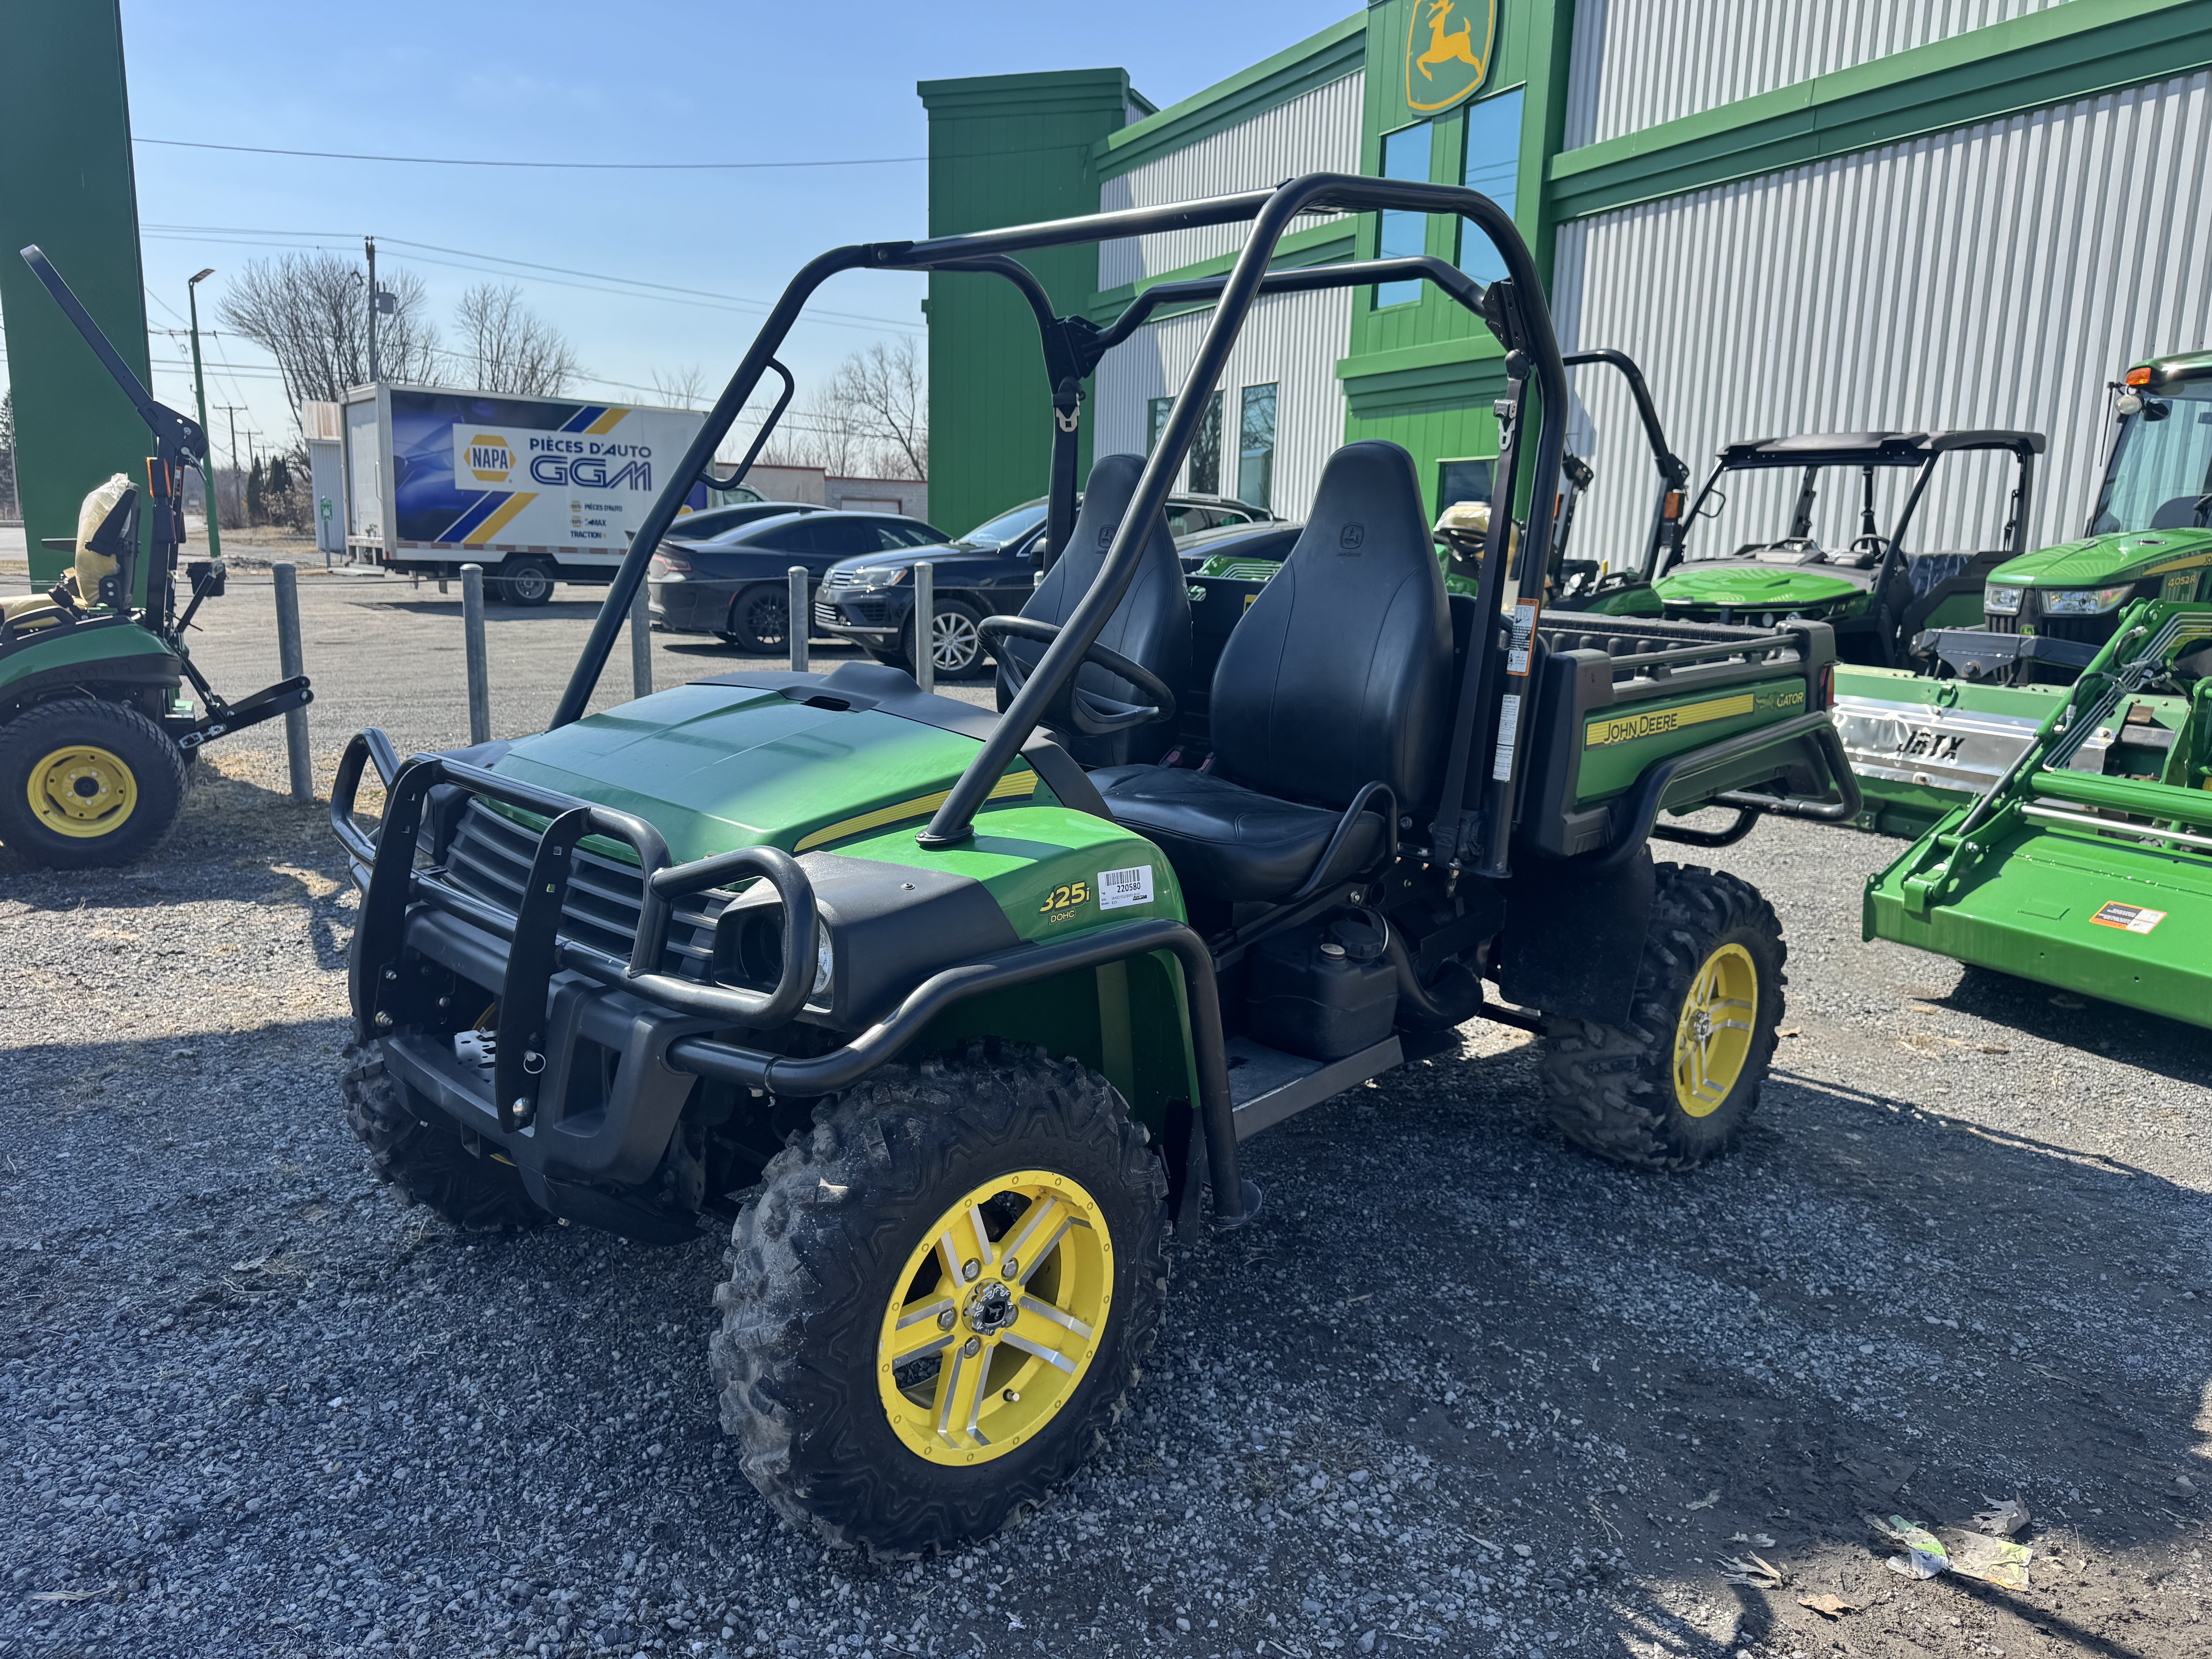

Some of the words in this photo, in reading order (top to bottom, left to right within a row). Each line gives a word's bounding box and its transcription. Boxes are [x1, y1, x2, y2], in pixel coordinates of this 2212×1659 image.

[529, 436, 584, 454] PIÈCES
[589, 442, 651, 458] D'AUTO
[472, 448, 508, 470] NAPA
[530, 455, 652, 491] GGM
[570, 531, 602, 539] TRACTION
[2168, 575, 2196, 588] 4052R
[1777, 692, 1803, 708] GATOR
[1603, 720, 1637, 742] JOHN
[1640, 713, 1678, 735] DEERE
[1116, 882, 1141, 893] 220580
[1051, 910, 1075, 923] DOHC
